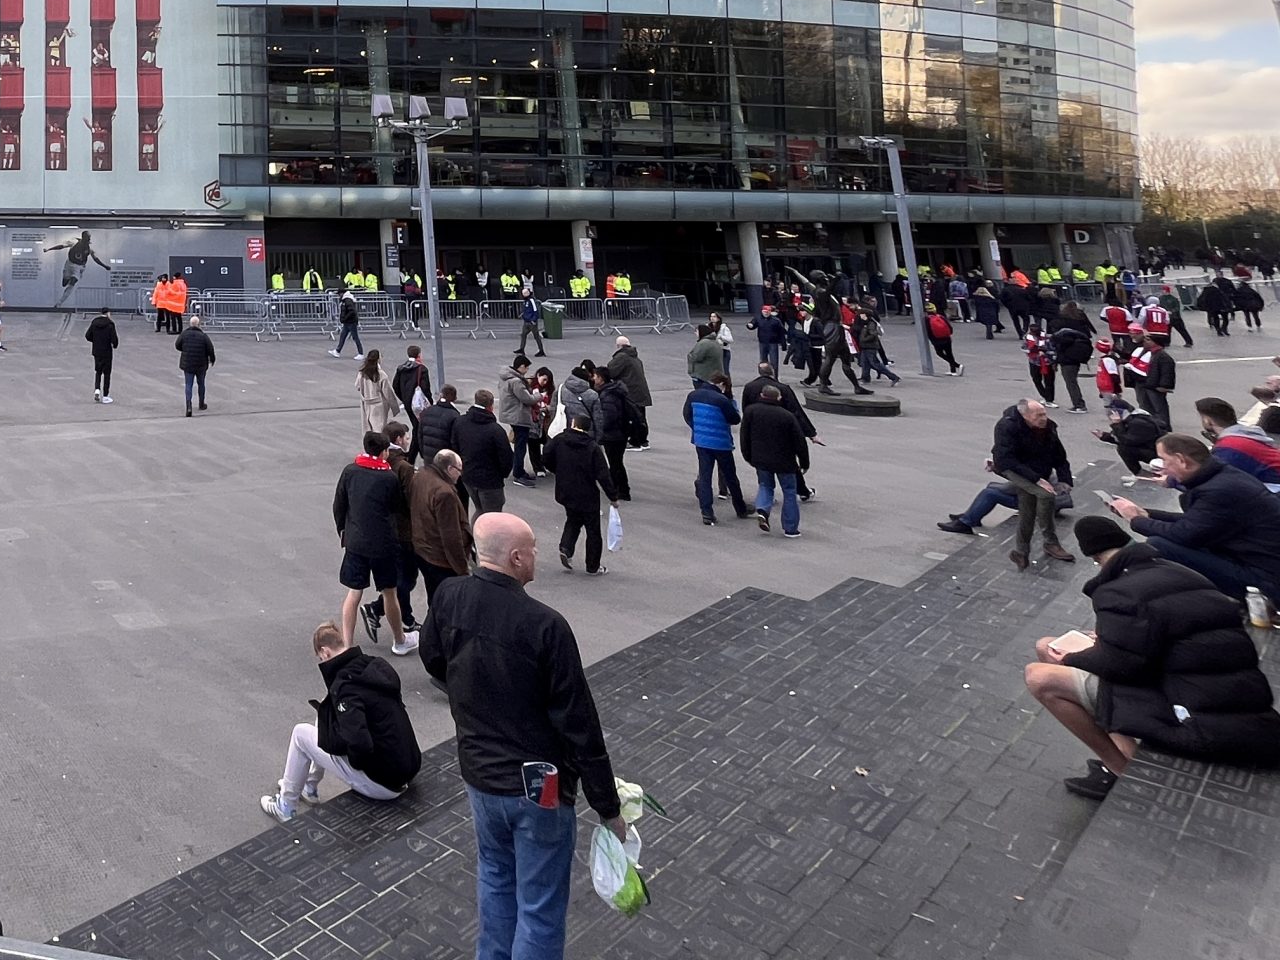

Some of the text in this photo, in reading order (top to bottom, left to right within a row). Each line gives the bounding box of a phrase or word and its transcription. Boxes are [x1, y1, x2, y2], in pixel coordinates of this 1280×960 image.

[397, 227, 404, 244] E
[1074, 229, 1090, 244] D
[1152, 311, 1162, 323] 11
